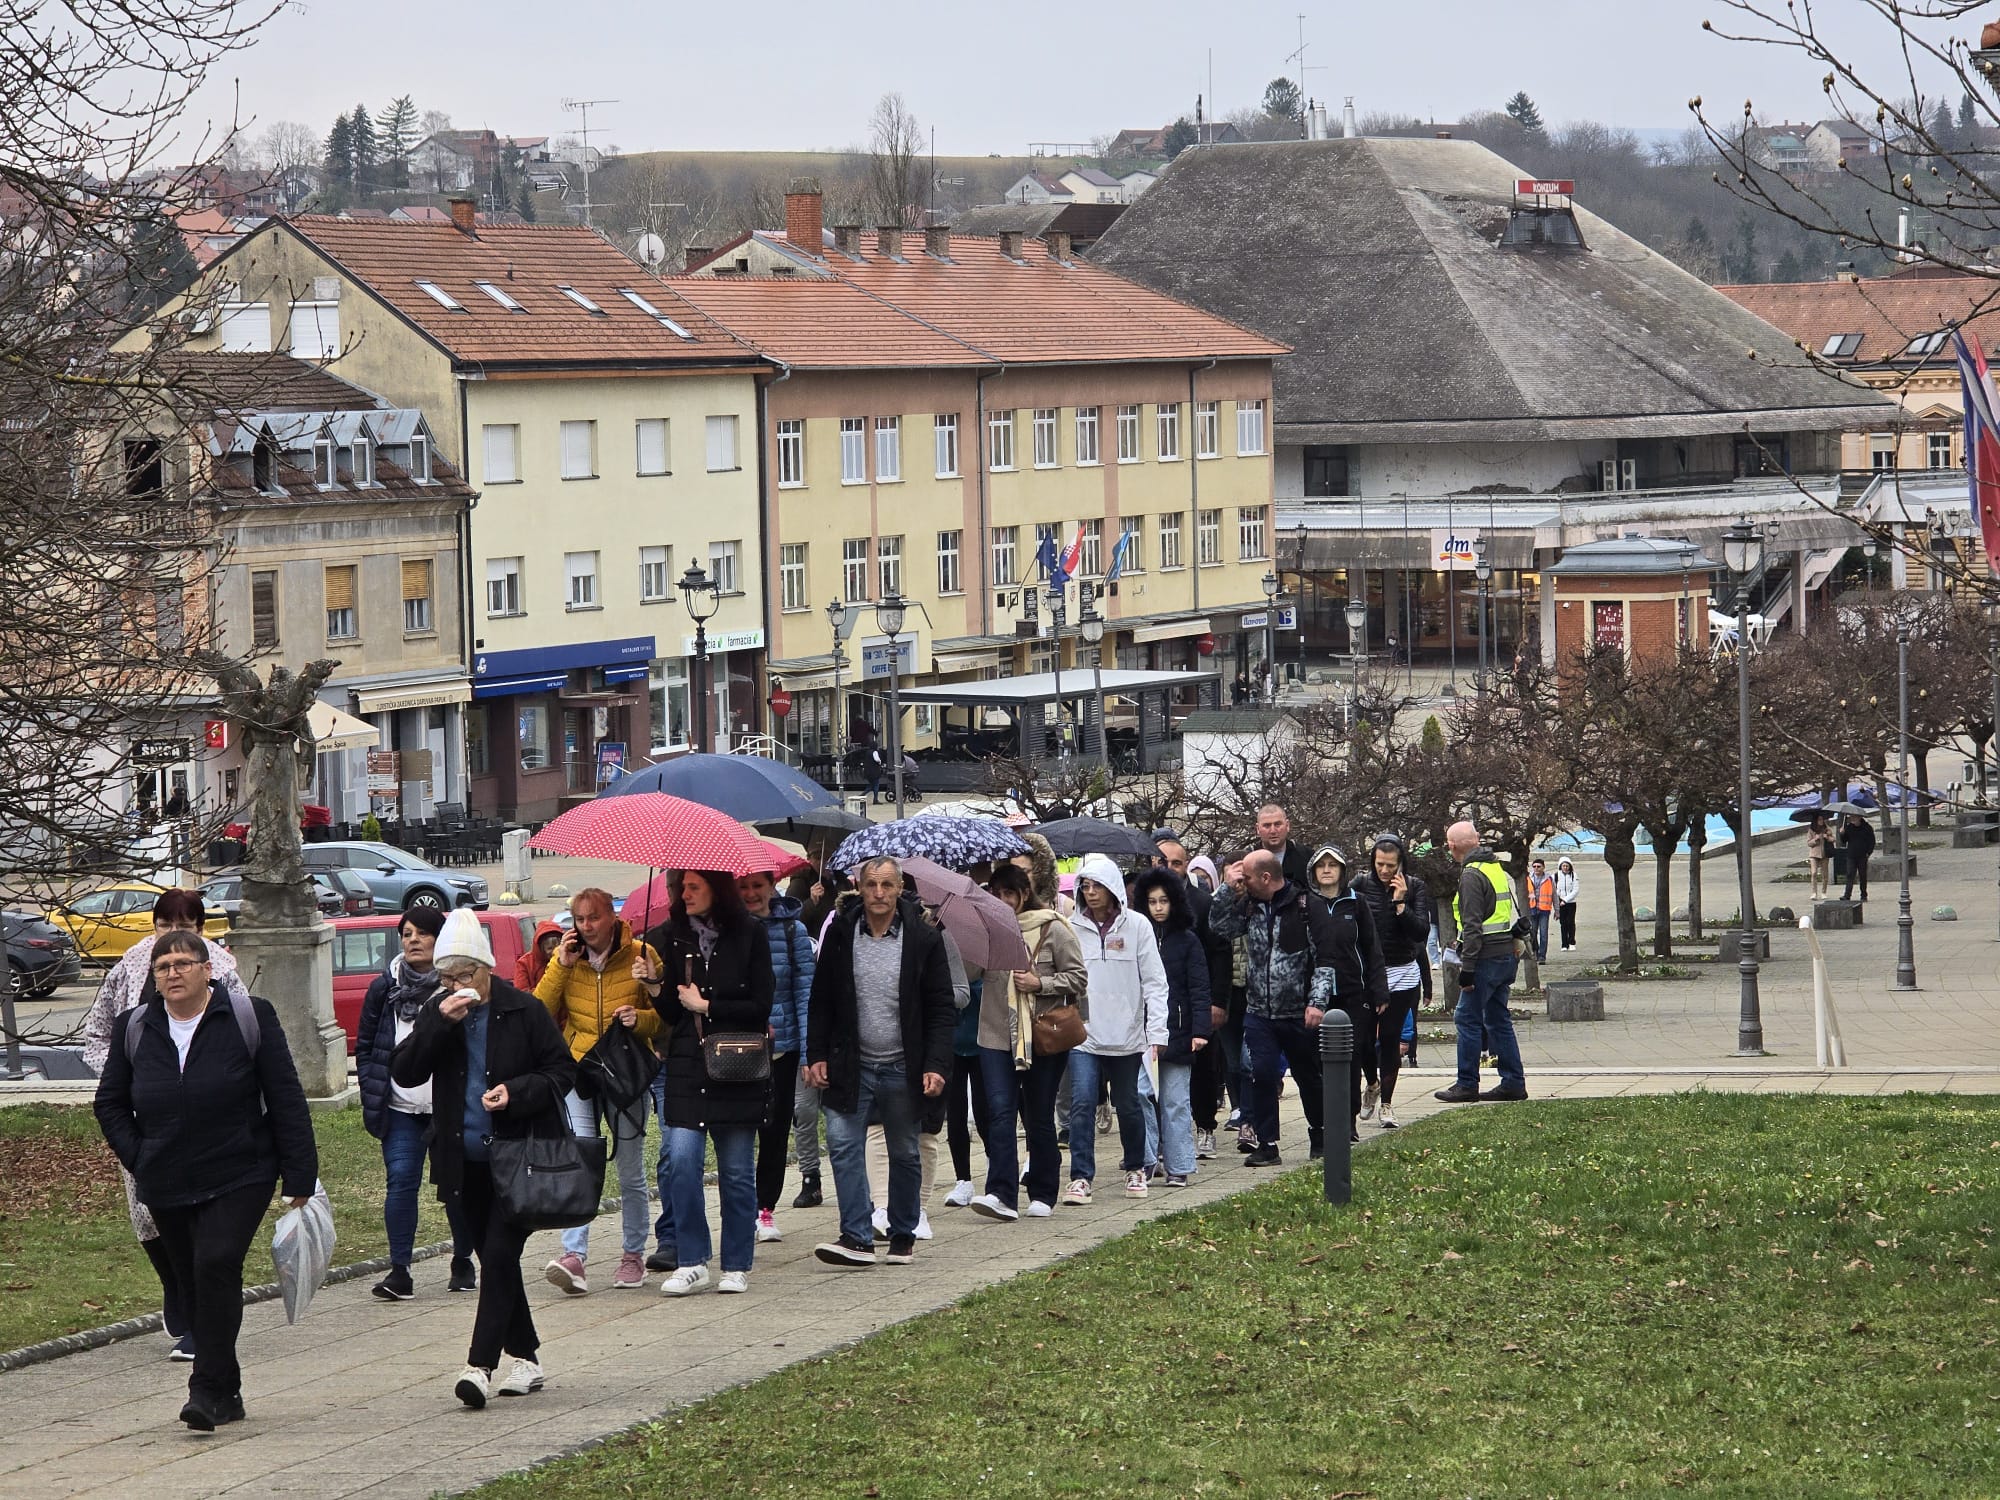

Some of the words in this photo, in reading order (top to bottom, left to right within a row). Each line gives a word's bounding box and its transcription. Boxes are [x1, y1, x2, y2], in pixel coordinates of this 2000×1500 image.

[1532, 182, 1560, 193] KONZUM
[1444, 535, 1469, 552] dm
[727, 634, 752, 647] farmacia
